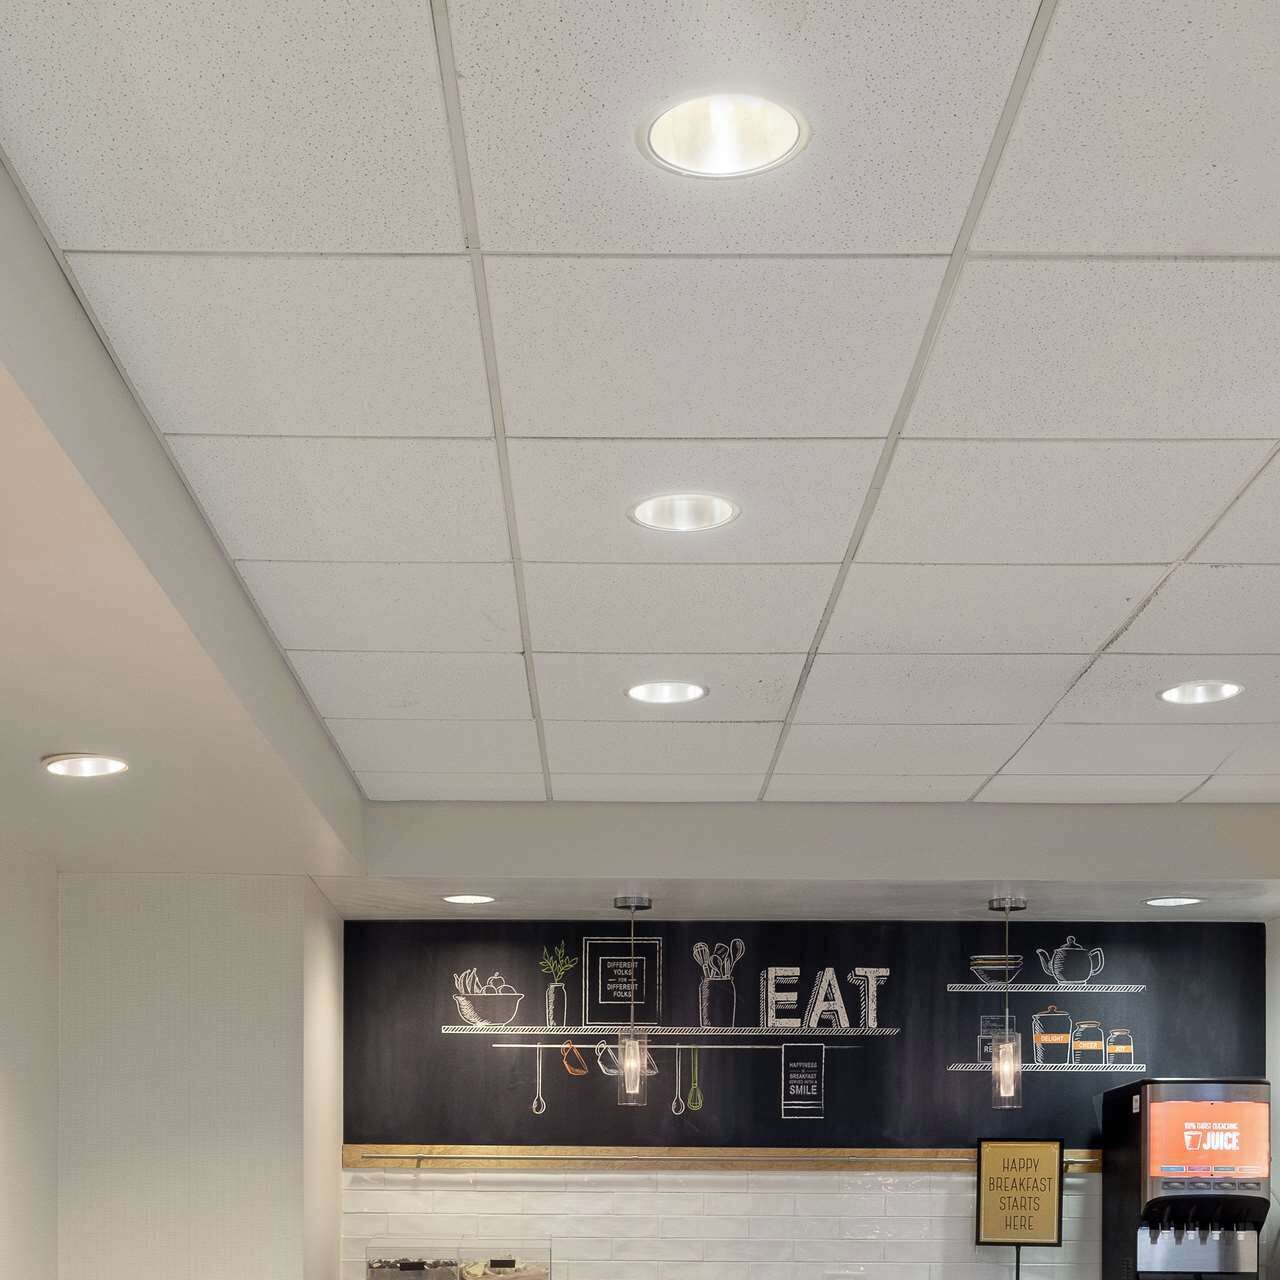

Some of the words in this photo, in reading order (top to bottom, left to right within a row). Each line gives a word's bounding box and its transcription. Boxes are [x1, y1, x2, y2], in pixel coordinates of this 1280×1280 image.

[613, 968, 632, 976] YOLKS
[760, 966, 890, 1028] EAT
[1041, 1034, 1065, 1042] DELIGHT
[1079, 1041, 1098, 1049] CHEER
[789, 1085, 817, 1095] SMILE
[1203, 1131, 1240, 1151] JUICE
[1002, 1158, 1040, 1172] HAPPY
[988, 1176, 1053, 1193] BREAKFAST
[999, 1196, 1040, 1211] STARTS
[1005, 1215, 1035, 1230] HERE
